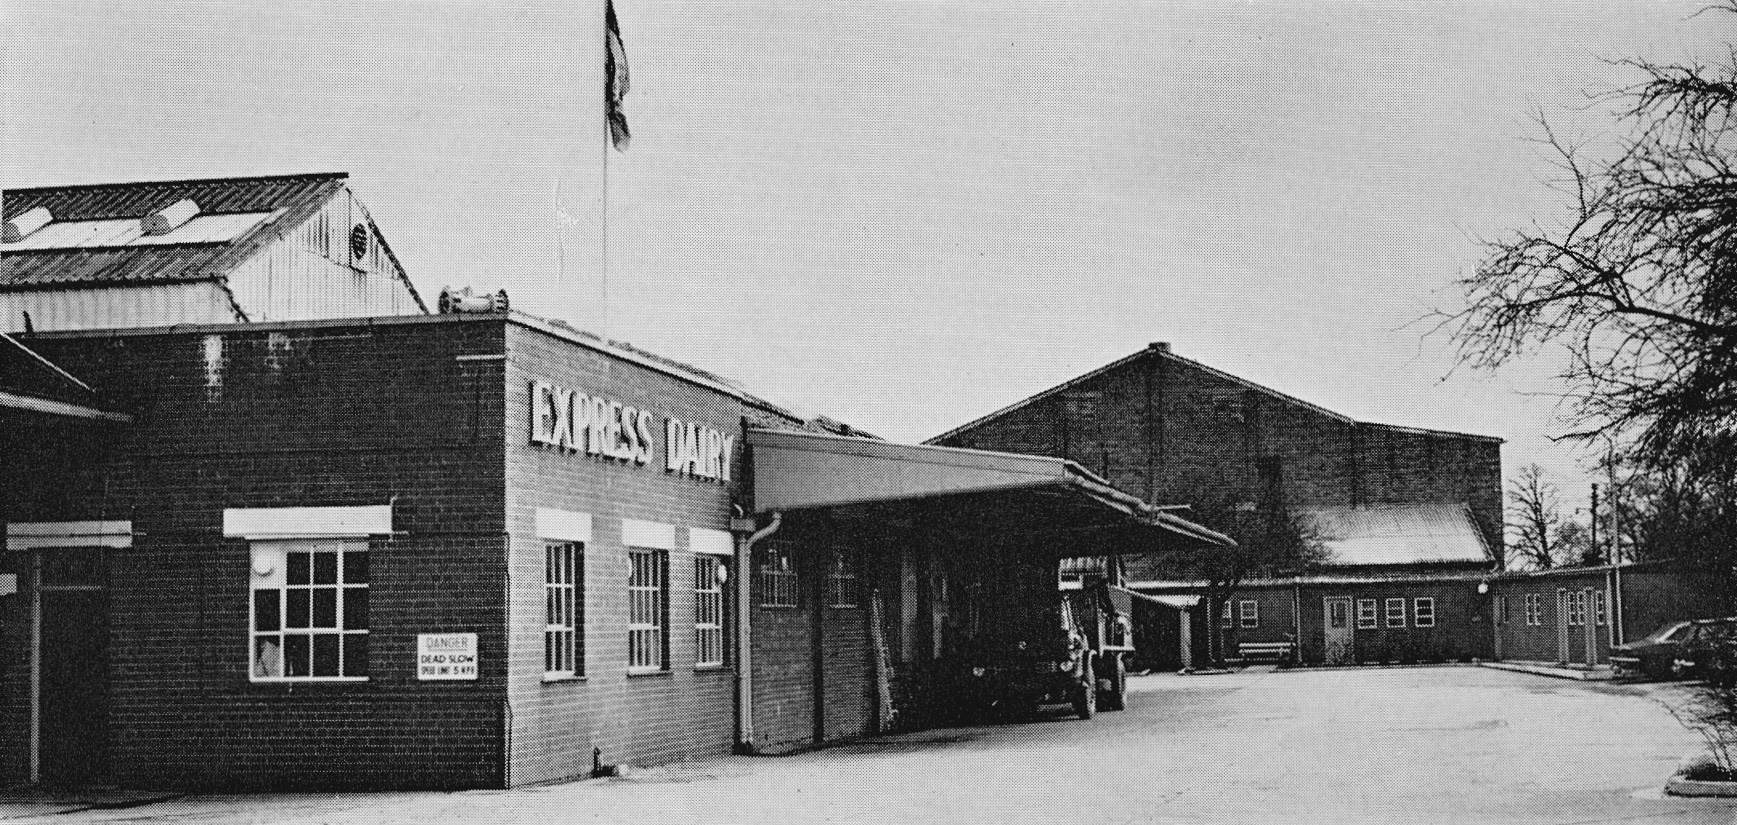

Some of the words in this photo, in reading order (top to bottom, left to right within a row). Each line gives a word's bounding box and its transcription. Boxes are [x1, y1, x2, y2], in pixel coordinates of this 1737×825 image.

[530, 380, 653, 466] EXPRESS
[666, 416, 735, 481] DAIRY
[426, 637, 468, 648] DANGER
[421, 655, 446, 663] DEAD
[449, 655, 474, 663] SLOW
[453, 666, 459, 675] 5
